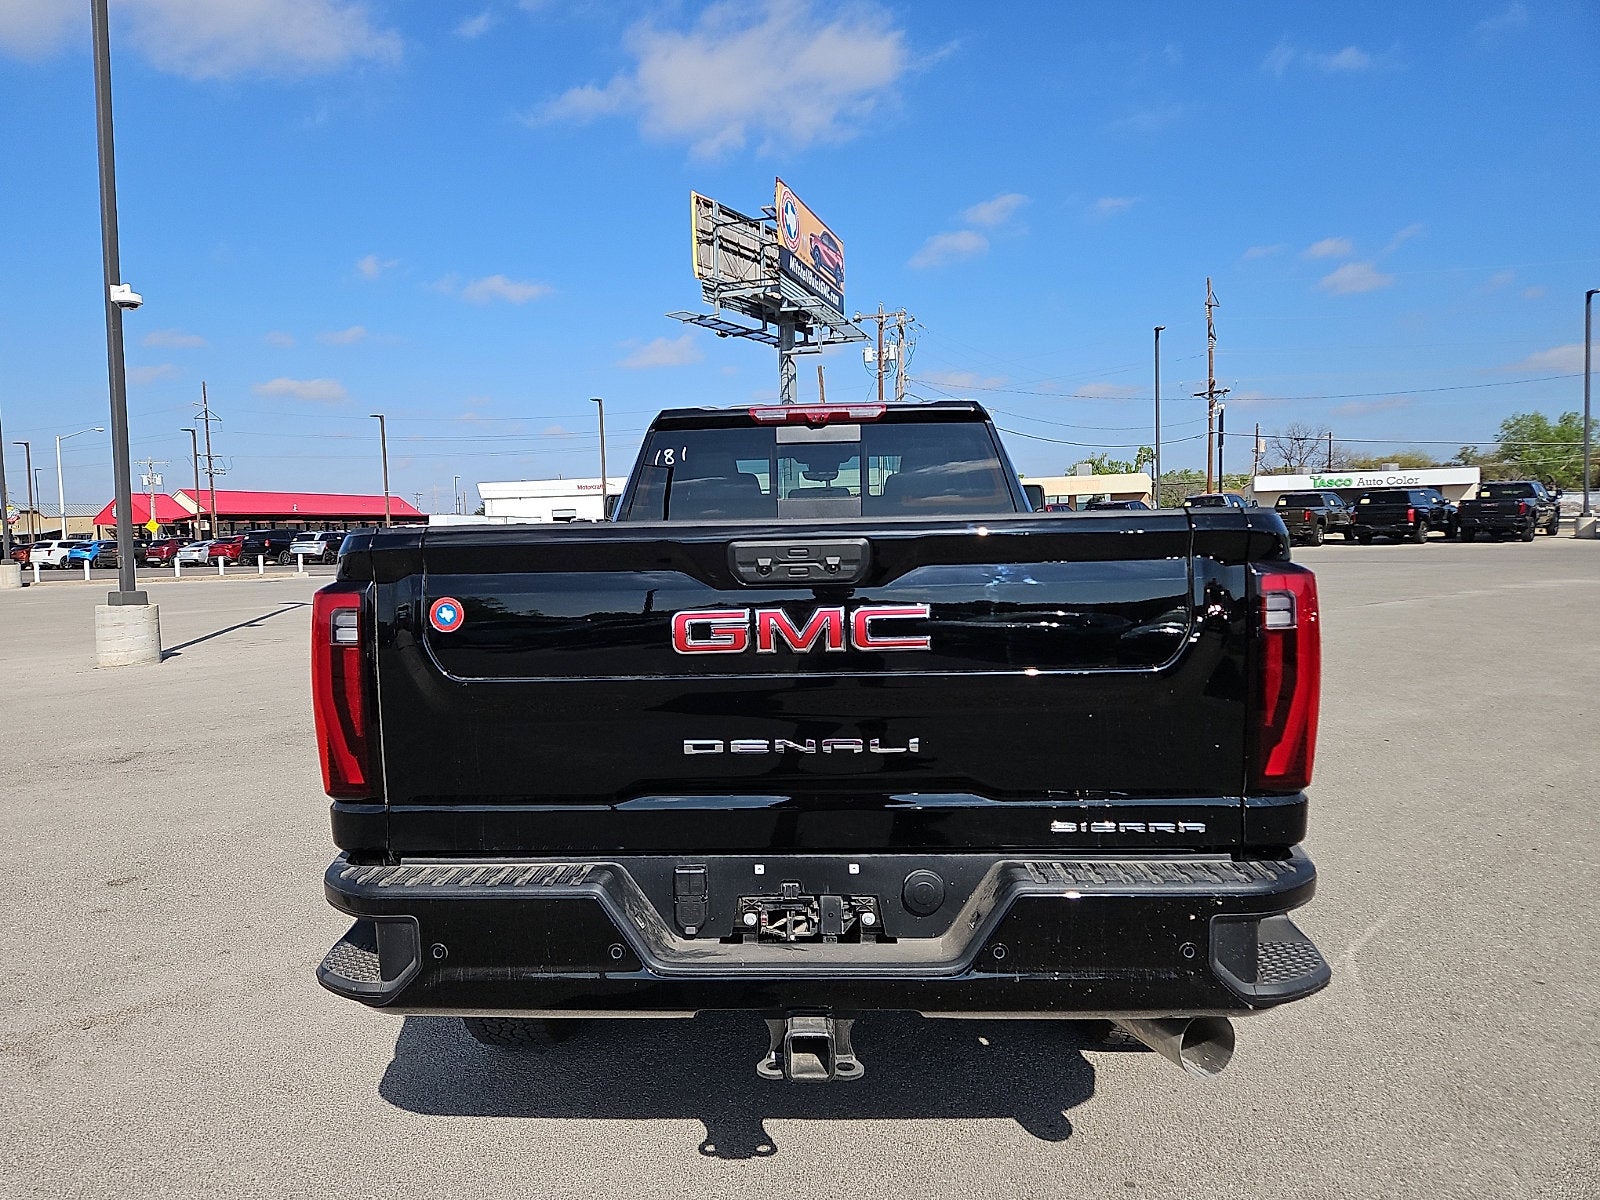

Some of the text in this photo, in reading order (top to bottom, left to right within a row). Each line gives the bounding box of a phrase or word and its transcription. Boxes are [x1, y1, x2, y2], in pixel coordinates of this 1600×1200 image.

[654, 446, 687, 466] 181
[1356, 477, 1383, 487] Auto
[1386, 475, 1420, 486] Color
[672, 603, 931, 655] GMC
[683, 737, 919, 754] DENALI
[1050, 820, 1206, 833] SIERRA
